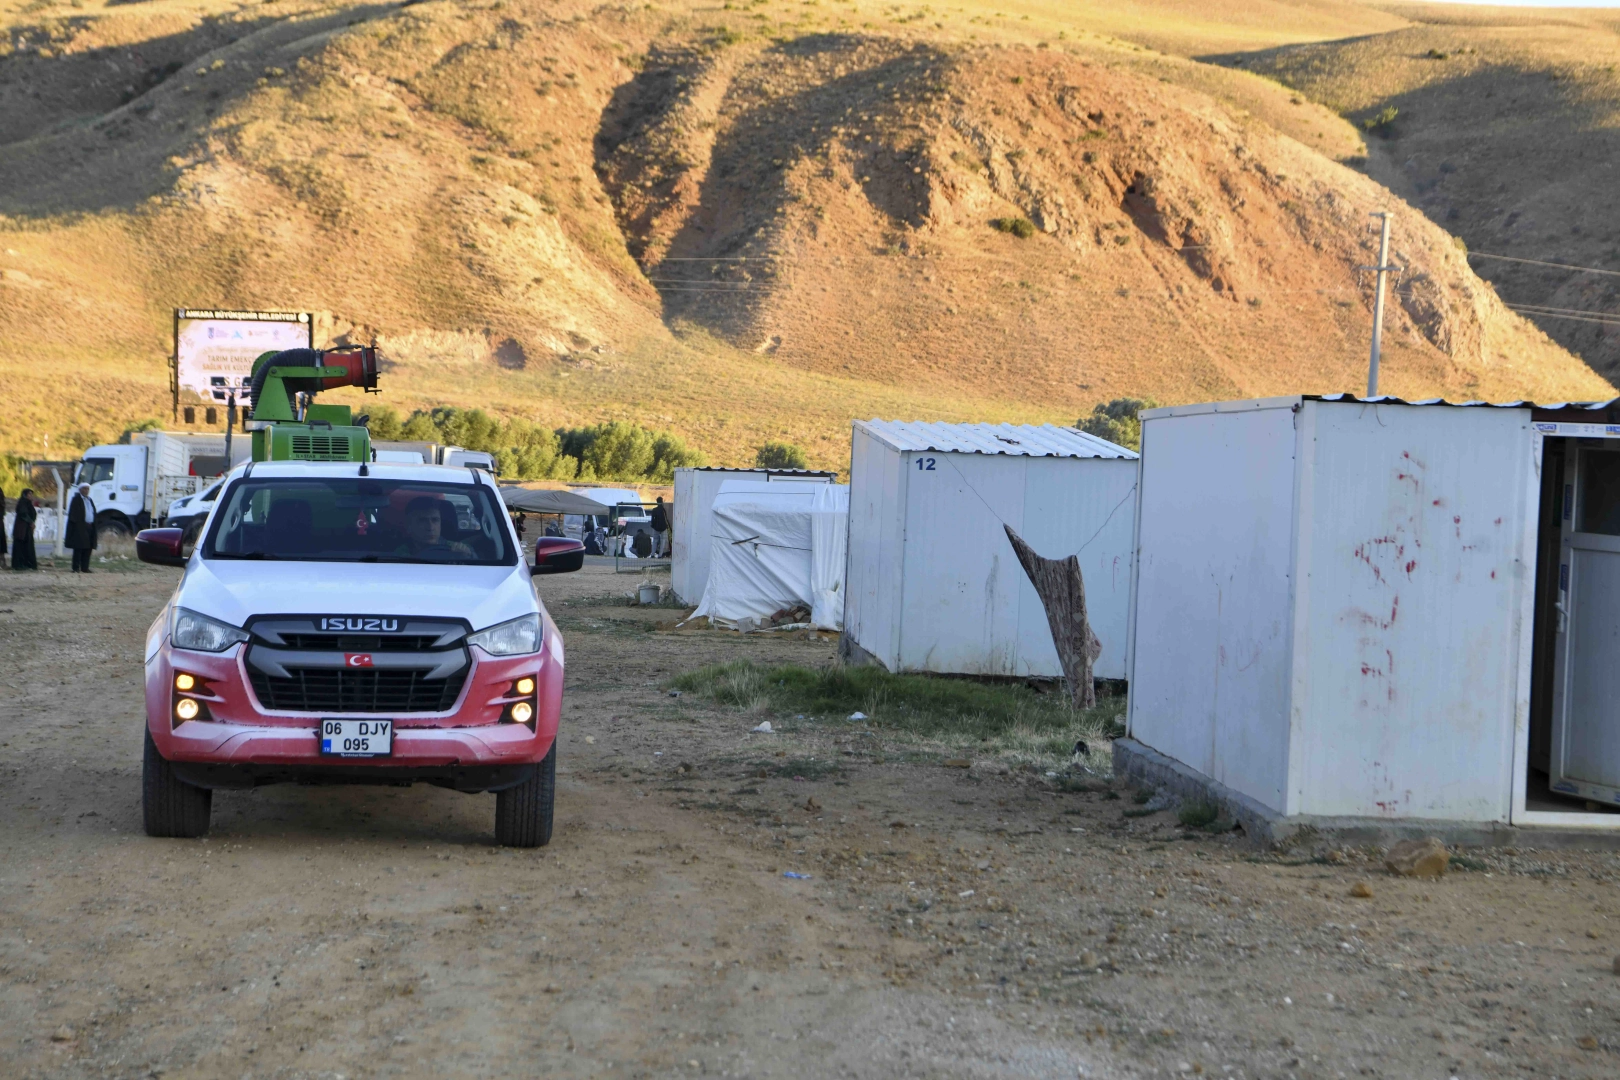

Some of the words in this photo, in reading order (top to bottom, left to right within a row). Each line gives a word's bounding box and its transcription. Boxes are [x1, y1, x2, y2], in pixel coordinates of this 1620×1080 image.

[186, 310, 214, 319] ANKARA
[215, 310, 258, 320] BÜYÜKŞEHİR
[258, 312, 297, 321] BELEDİYESİ
[230, 355, 253, 364] EMEKÇ
[202, 362, 222, 370] SAĞLIK
[916, 458, 936, 470] 12
[321, 618, 397, 631] ISUZU
[325, 722, 342, 735] 06
[359, 722, 389, 736] DJY
[343, 738, 369, 751] 095
